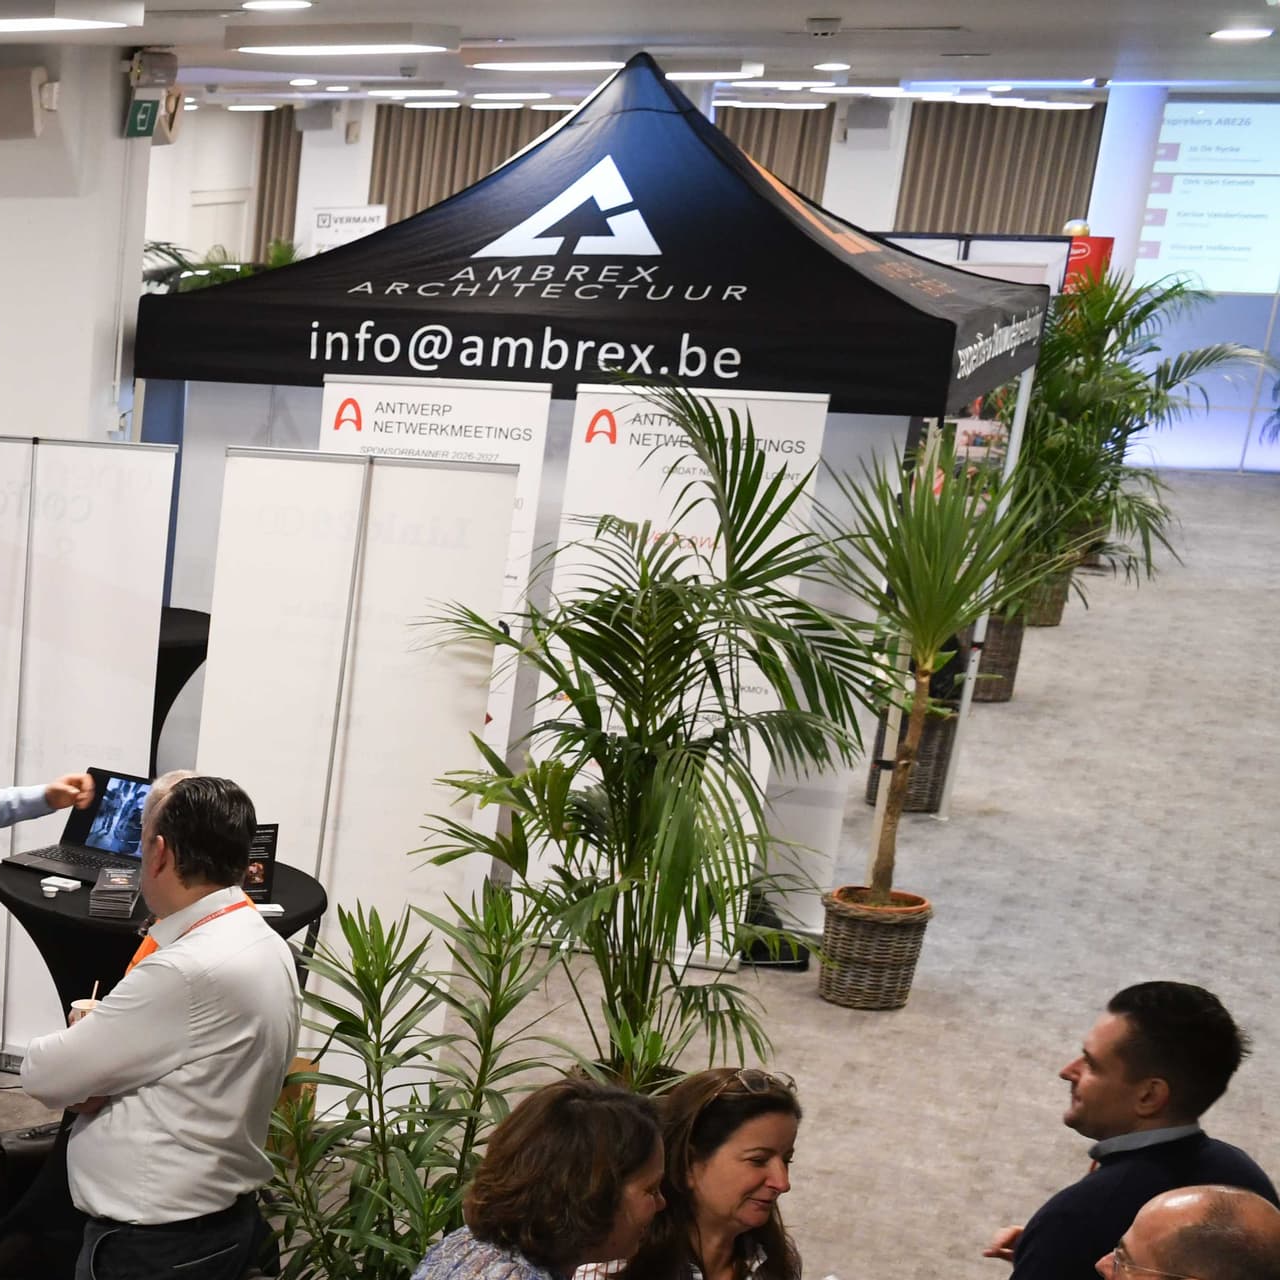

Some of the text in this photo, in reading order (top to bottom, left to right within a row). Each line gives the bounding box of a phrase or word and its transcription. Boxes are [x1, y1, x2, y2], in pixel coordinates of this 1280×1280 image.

[332, 216, 380, 224] VERMANT
[448, 265, 662, 283] AMBREX
[347, 281, 749, 301] ARCHITECTUUR
[309, 320, 742, 378] info@ambrex.be
[374, 401, 452, 417] ANTWERP
[373, 420, 534, 442] NETWERKMEETINGS
